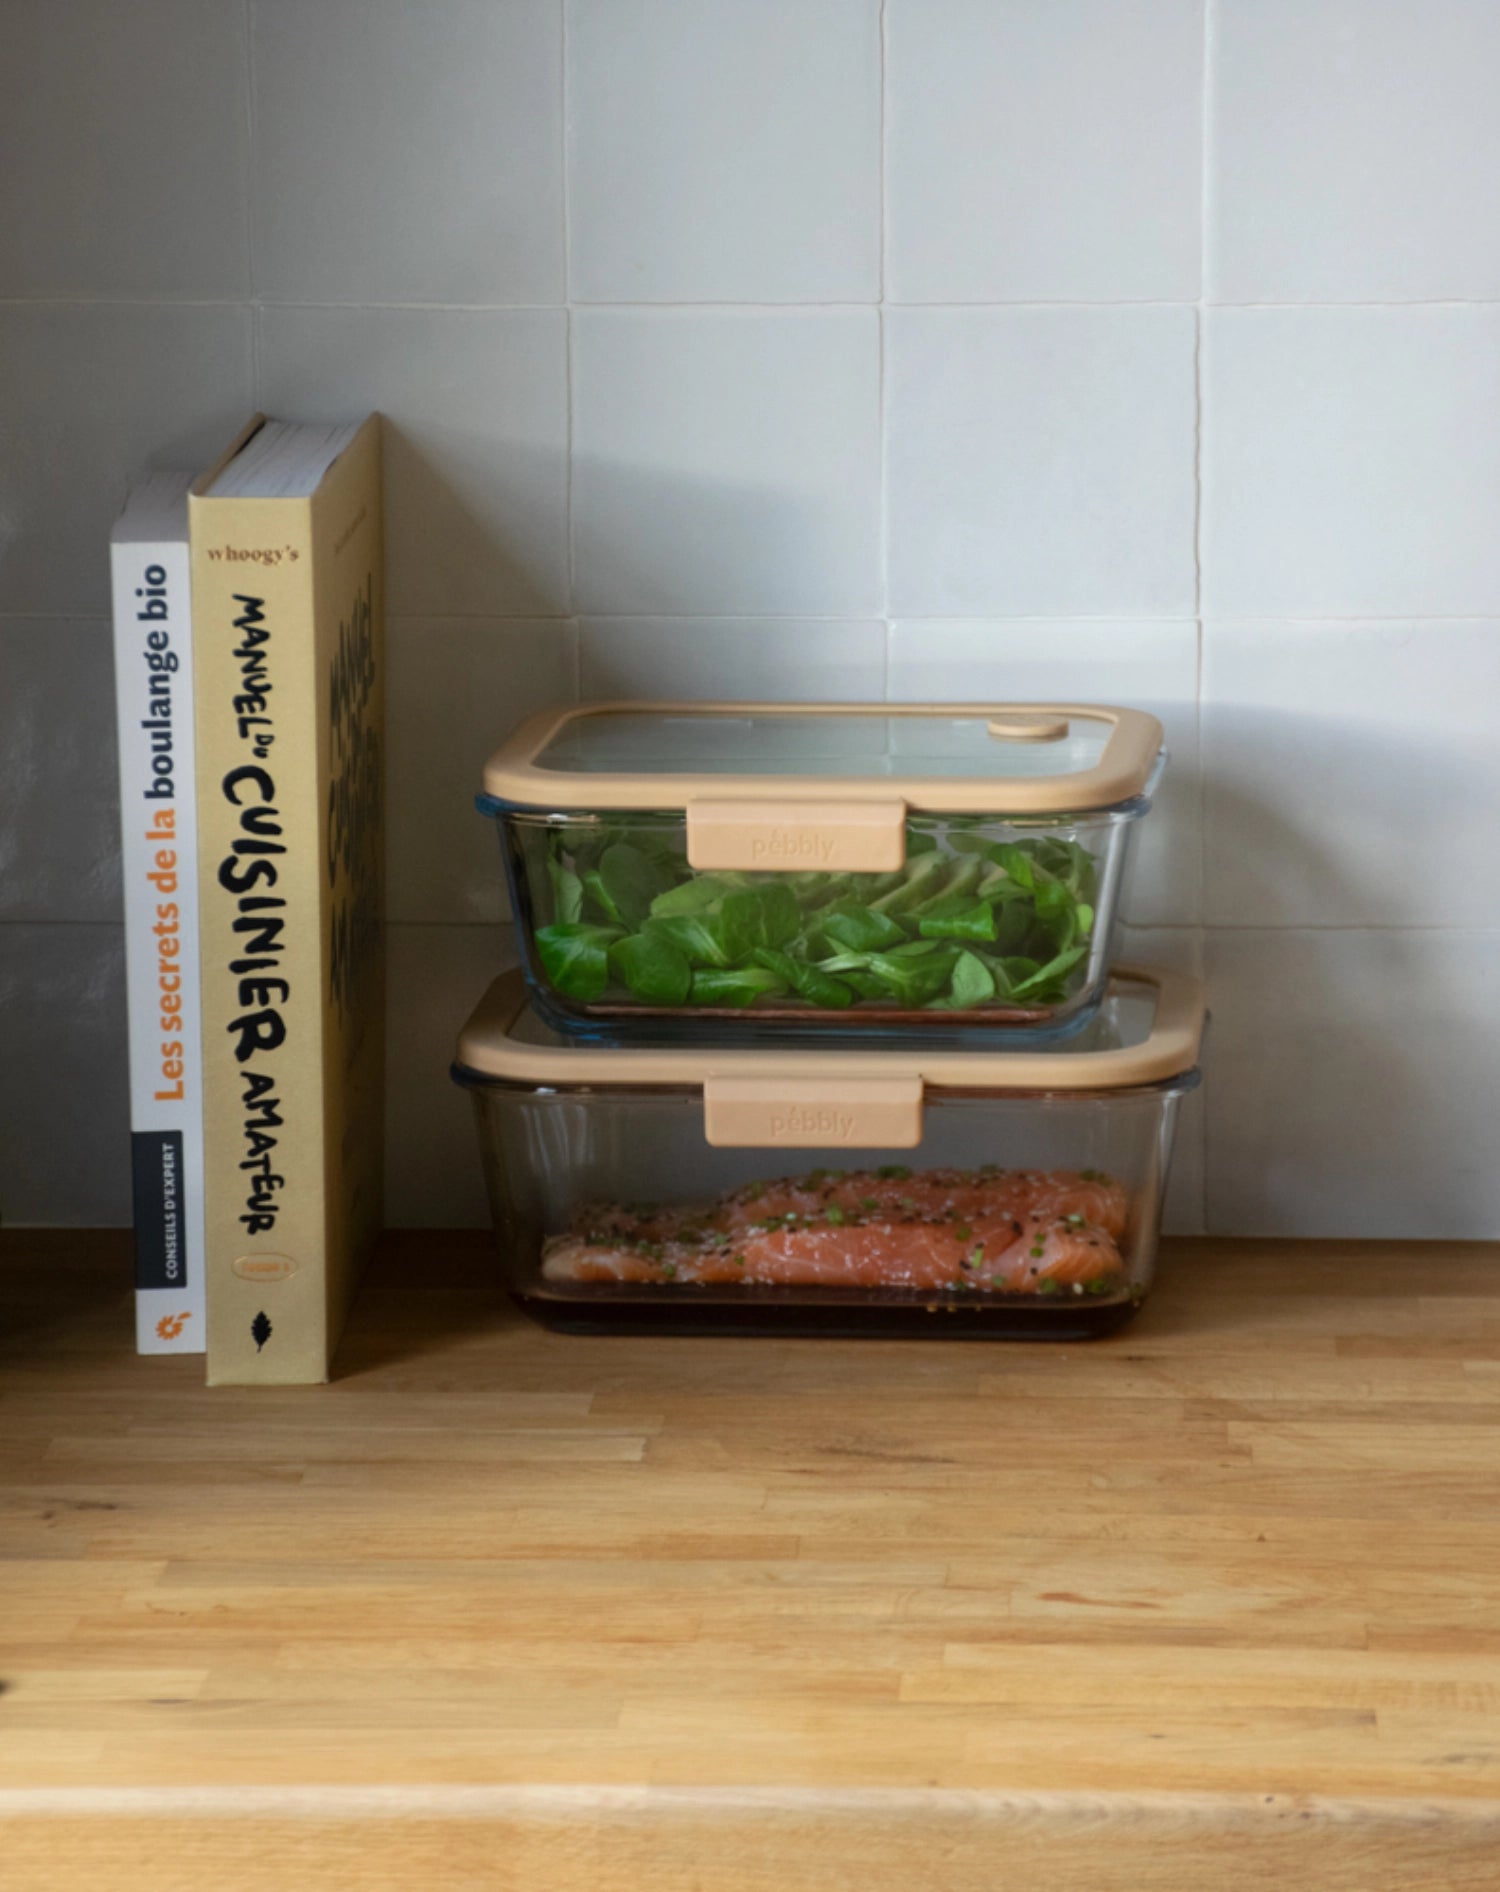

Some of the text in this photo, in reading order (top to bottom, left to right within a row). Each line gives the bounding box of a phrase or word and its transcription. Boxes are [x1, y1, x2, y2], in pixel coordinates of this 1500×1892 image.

[207, 546, 299, 566] whoogy's
[232, 593, 273, 739] MANUEL
[252, 733, 275, 759] DU
[136, 564, 185, 1102] Les secrets de la boulange bio
[751, 828, 834, 862] pébbly
[218, 765, 290, 1063] CUISINIER
[239, 1071, 284, 1235] AMATEUR
[769, 1106, 853, 1138] pébbly
[162, 1142, 180, 1279] CONSEILS D'EXPERT
